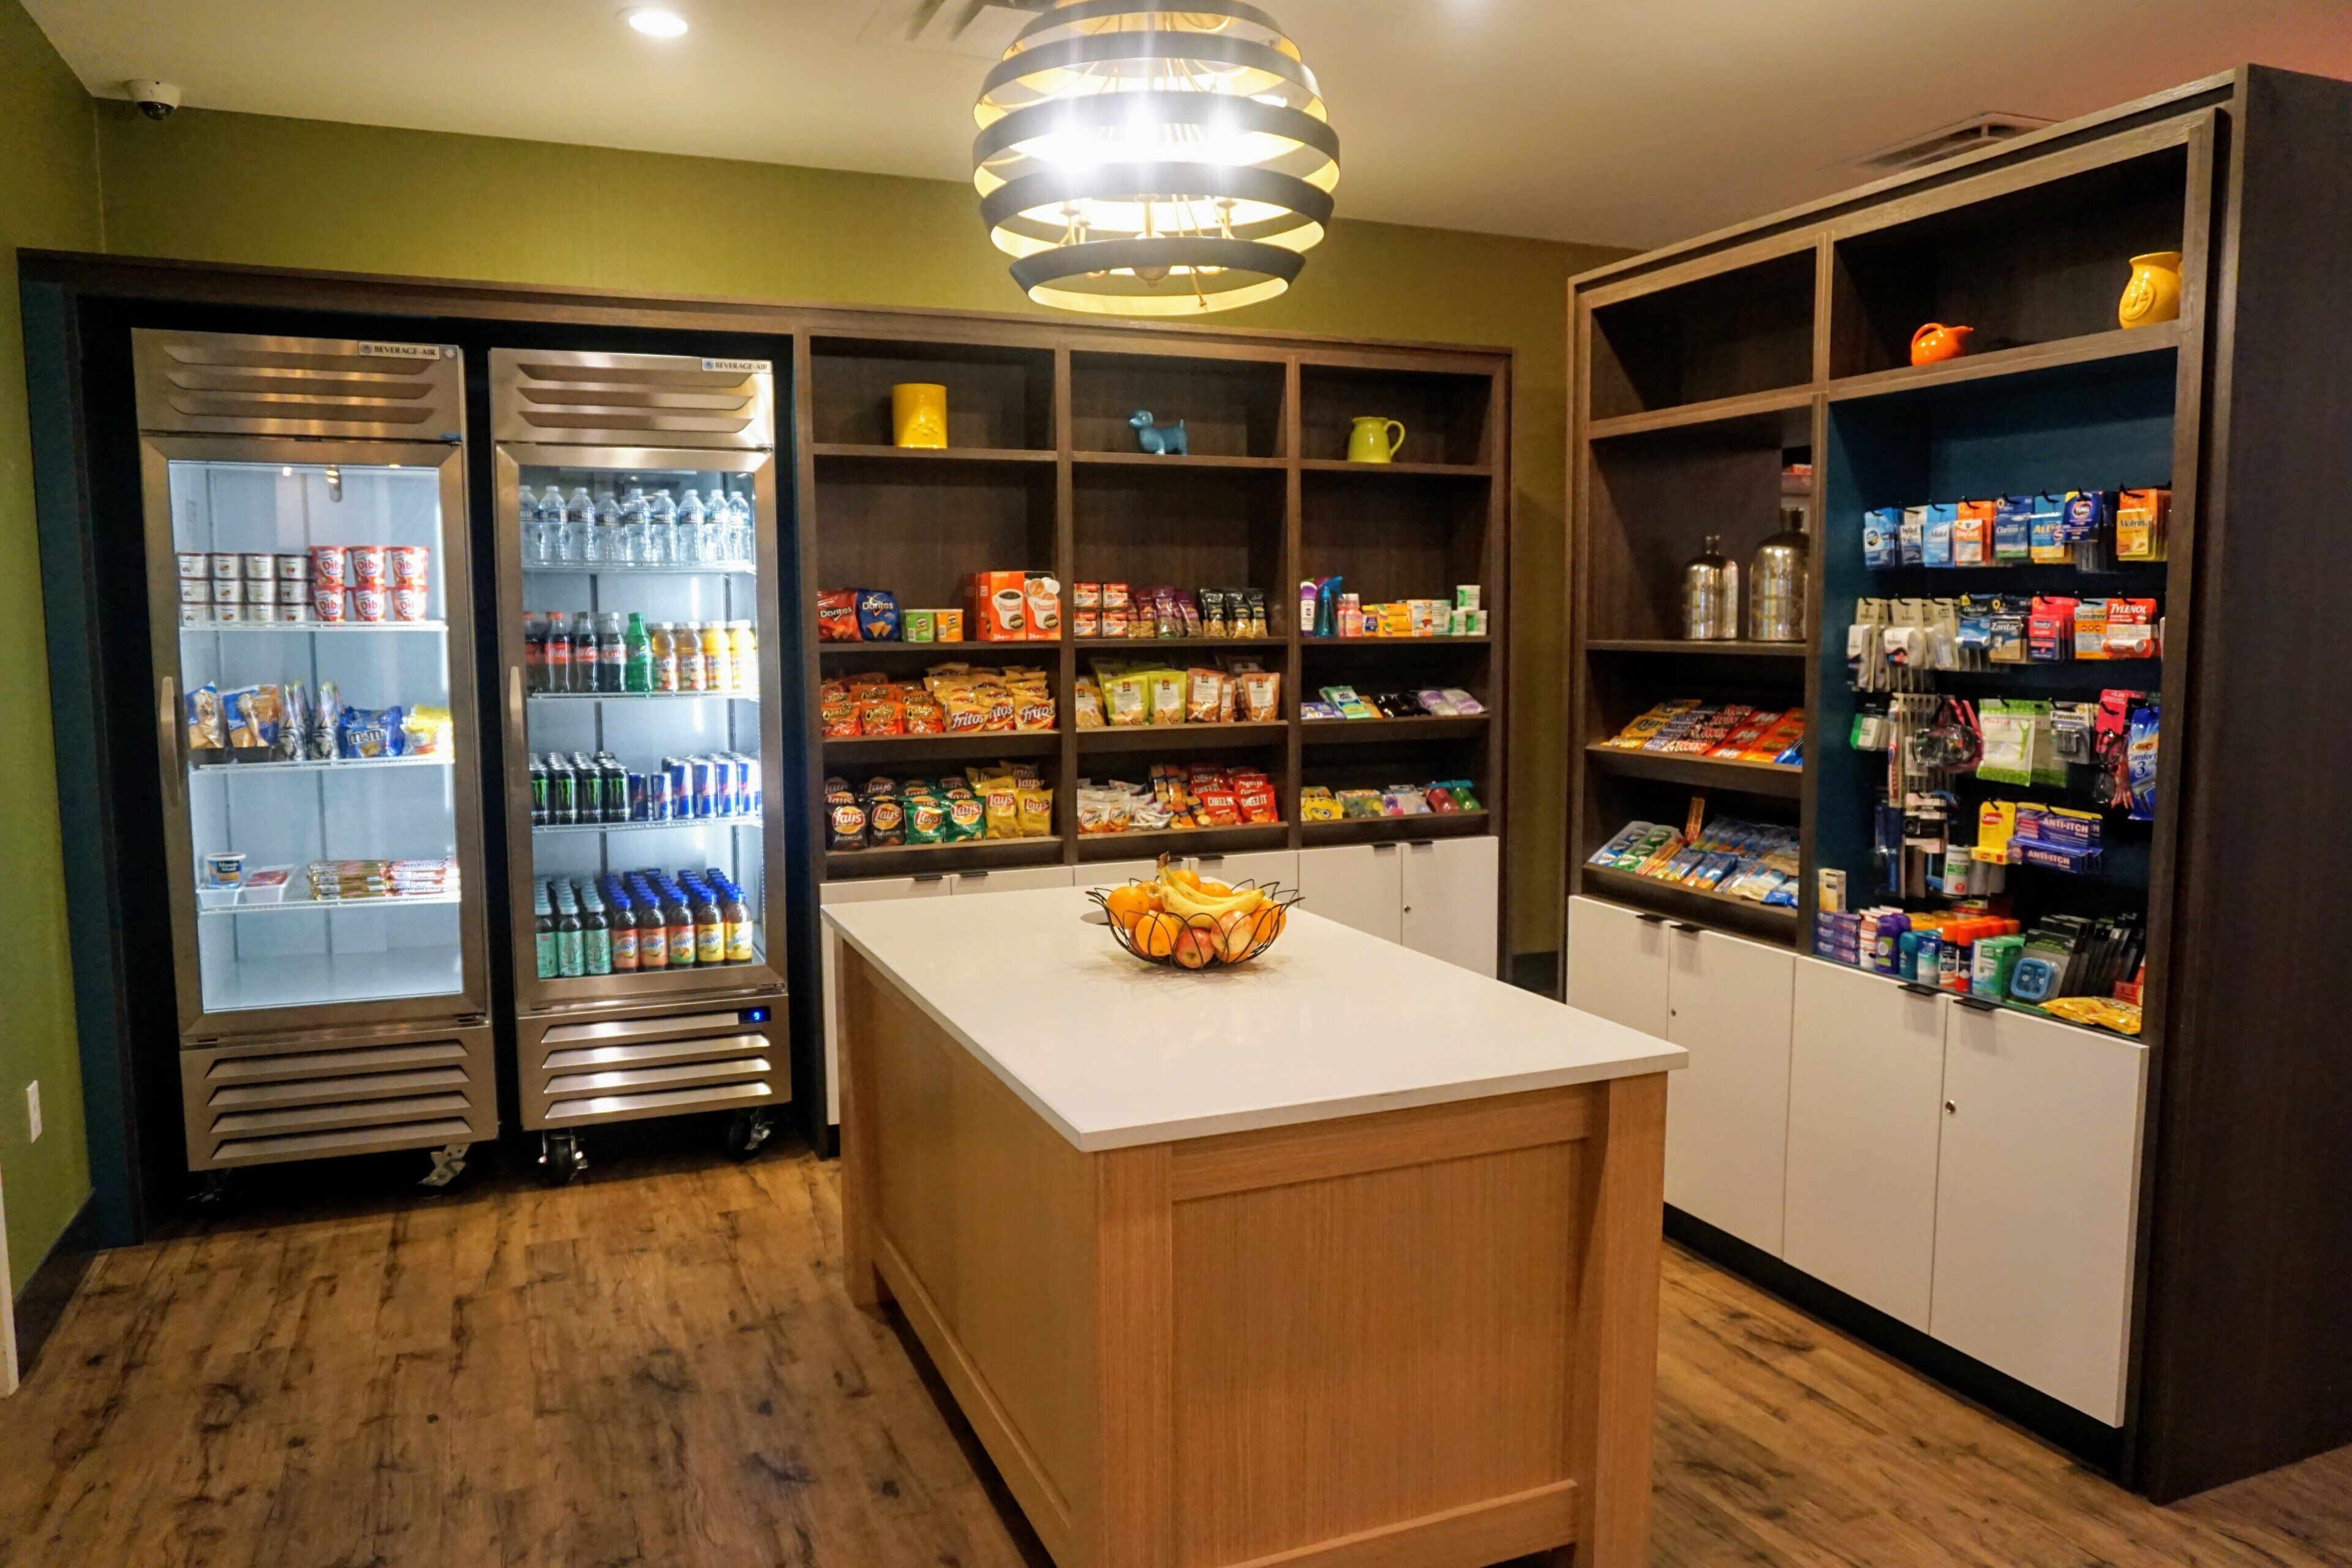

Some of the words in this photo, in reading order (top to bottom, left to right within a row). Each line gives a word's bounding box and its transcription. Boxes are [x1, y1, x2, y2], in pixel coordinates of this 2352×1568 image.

[374, 345, 435, 355] BEVERAGE-AIR
[715, 361, 767, 370] BEVERAGE-AIR
[1957, 530, 1979, 539] DayQuil
[322, 559, 344, 570] Dib
[398, 559, 415, 570] Dib
[361, 599, 383, 610] Dib
[862, 601, 894, 611] Doritos
[2110, 603, 2147, 614] TYLENOL
[820, 606, 853, 618] Doritos
[1991, 622, 2019, 631] Zantac
[822, 707, 852, 721] Cheetos
[864, 704, 895, 722] Cheetos
[905, 706, 934, 720] Cheetos
[951, 710, 984, 729] Fritos
[989, 704, 1014, 722] ritos
[1020, 704, 1054, 724] Fritos
[2052, 712, 2086, 721] Panasonic
[2135, 761, 2146, 776] 3
[989, 794, 1014, 807] Lay's
[1027, 799, 1049, 812] Lay's
[835, 809, 862, 826] Lay's
[875, 807, 899, 822] Lay's
[916, 810, 938, 825] Lay's
[954, 804, 979, 818] Lay's
[2043, 818, 2089, 832] ANTI-ITCH
[2027, 850, 2070, 865] ANTI-ITCH
[733, 935, 752, 945] Snapp
